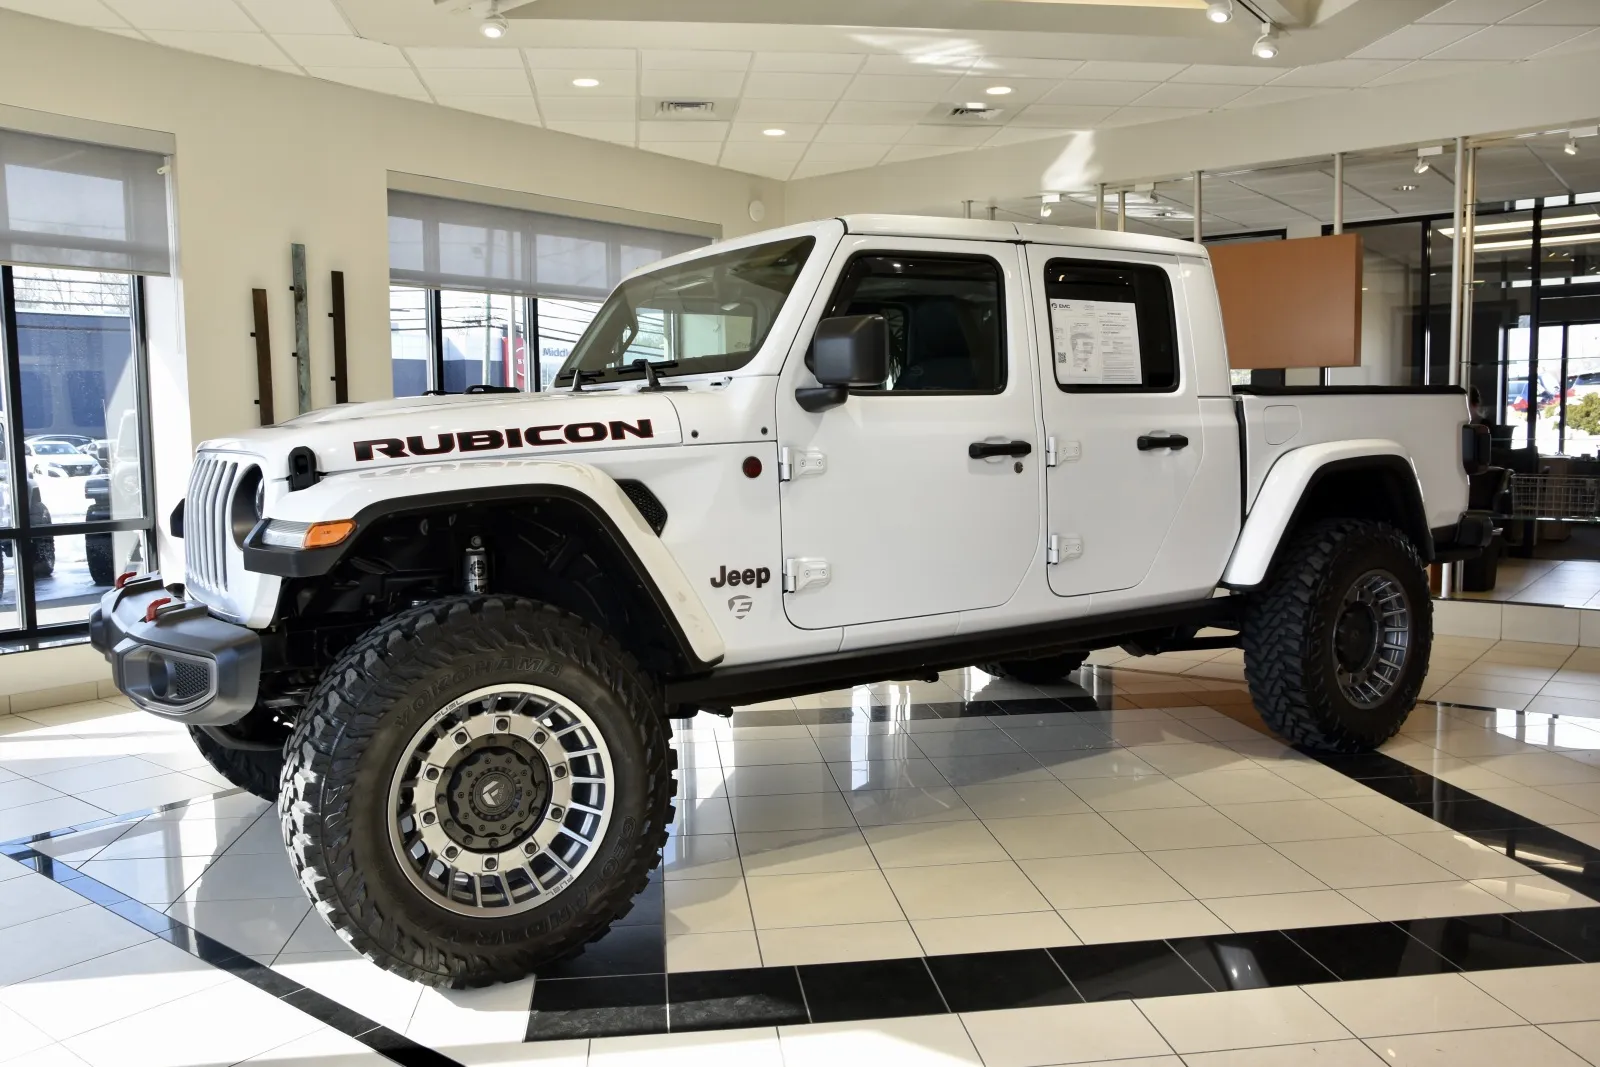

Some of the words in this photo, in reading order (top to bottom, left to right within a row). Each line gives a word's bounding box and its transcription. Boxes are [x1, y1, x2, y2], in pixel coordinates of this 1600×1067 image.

[353, 418, 654, 462] RUBICON
[710, 565, 771, 589] Jeep
[394, 656, 564, 728] YOKOHAMA
[434, 700, 464, 722] FUEL
[546, 874, 574, 896] FUEL
